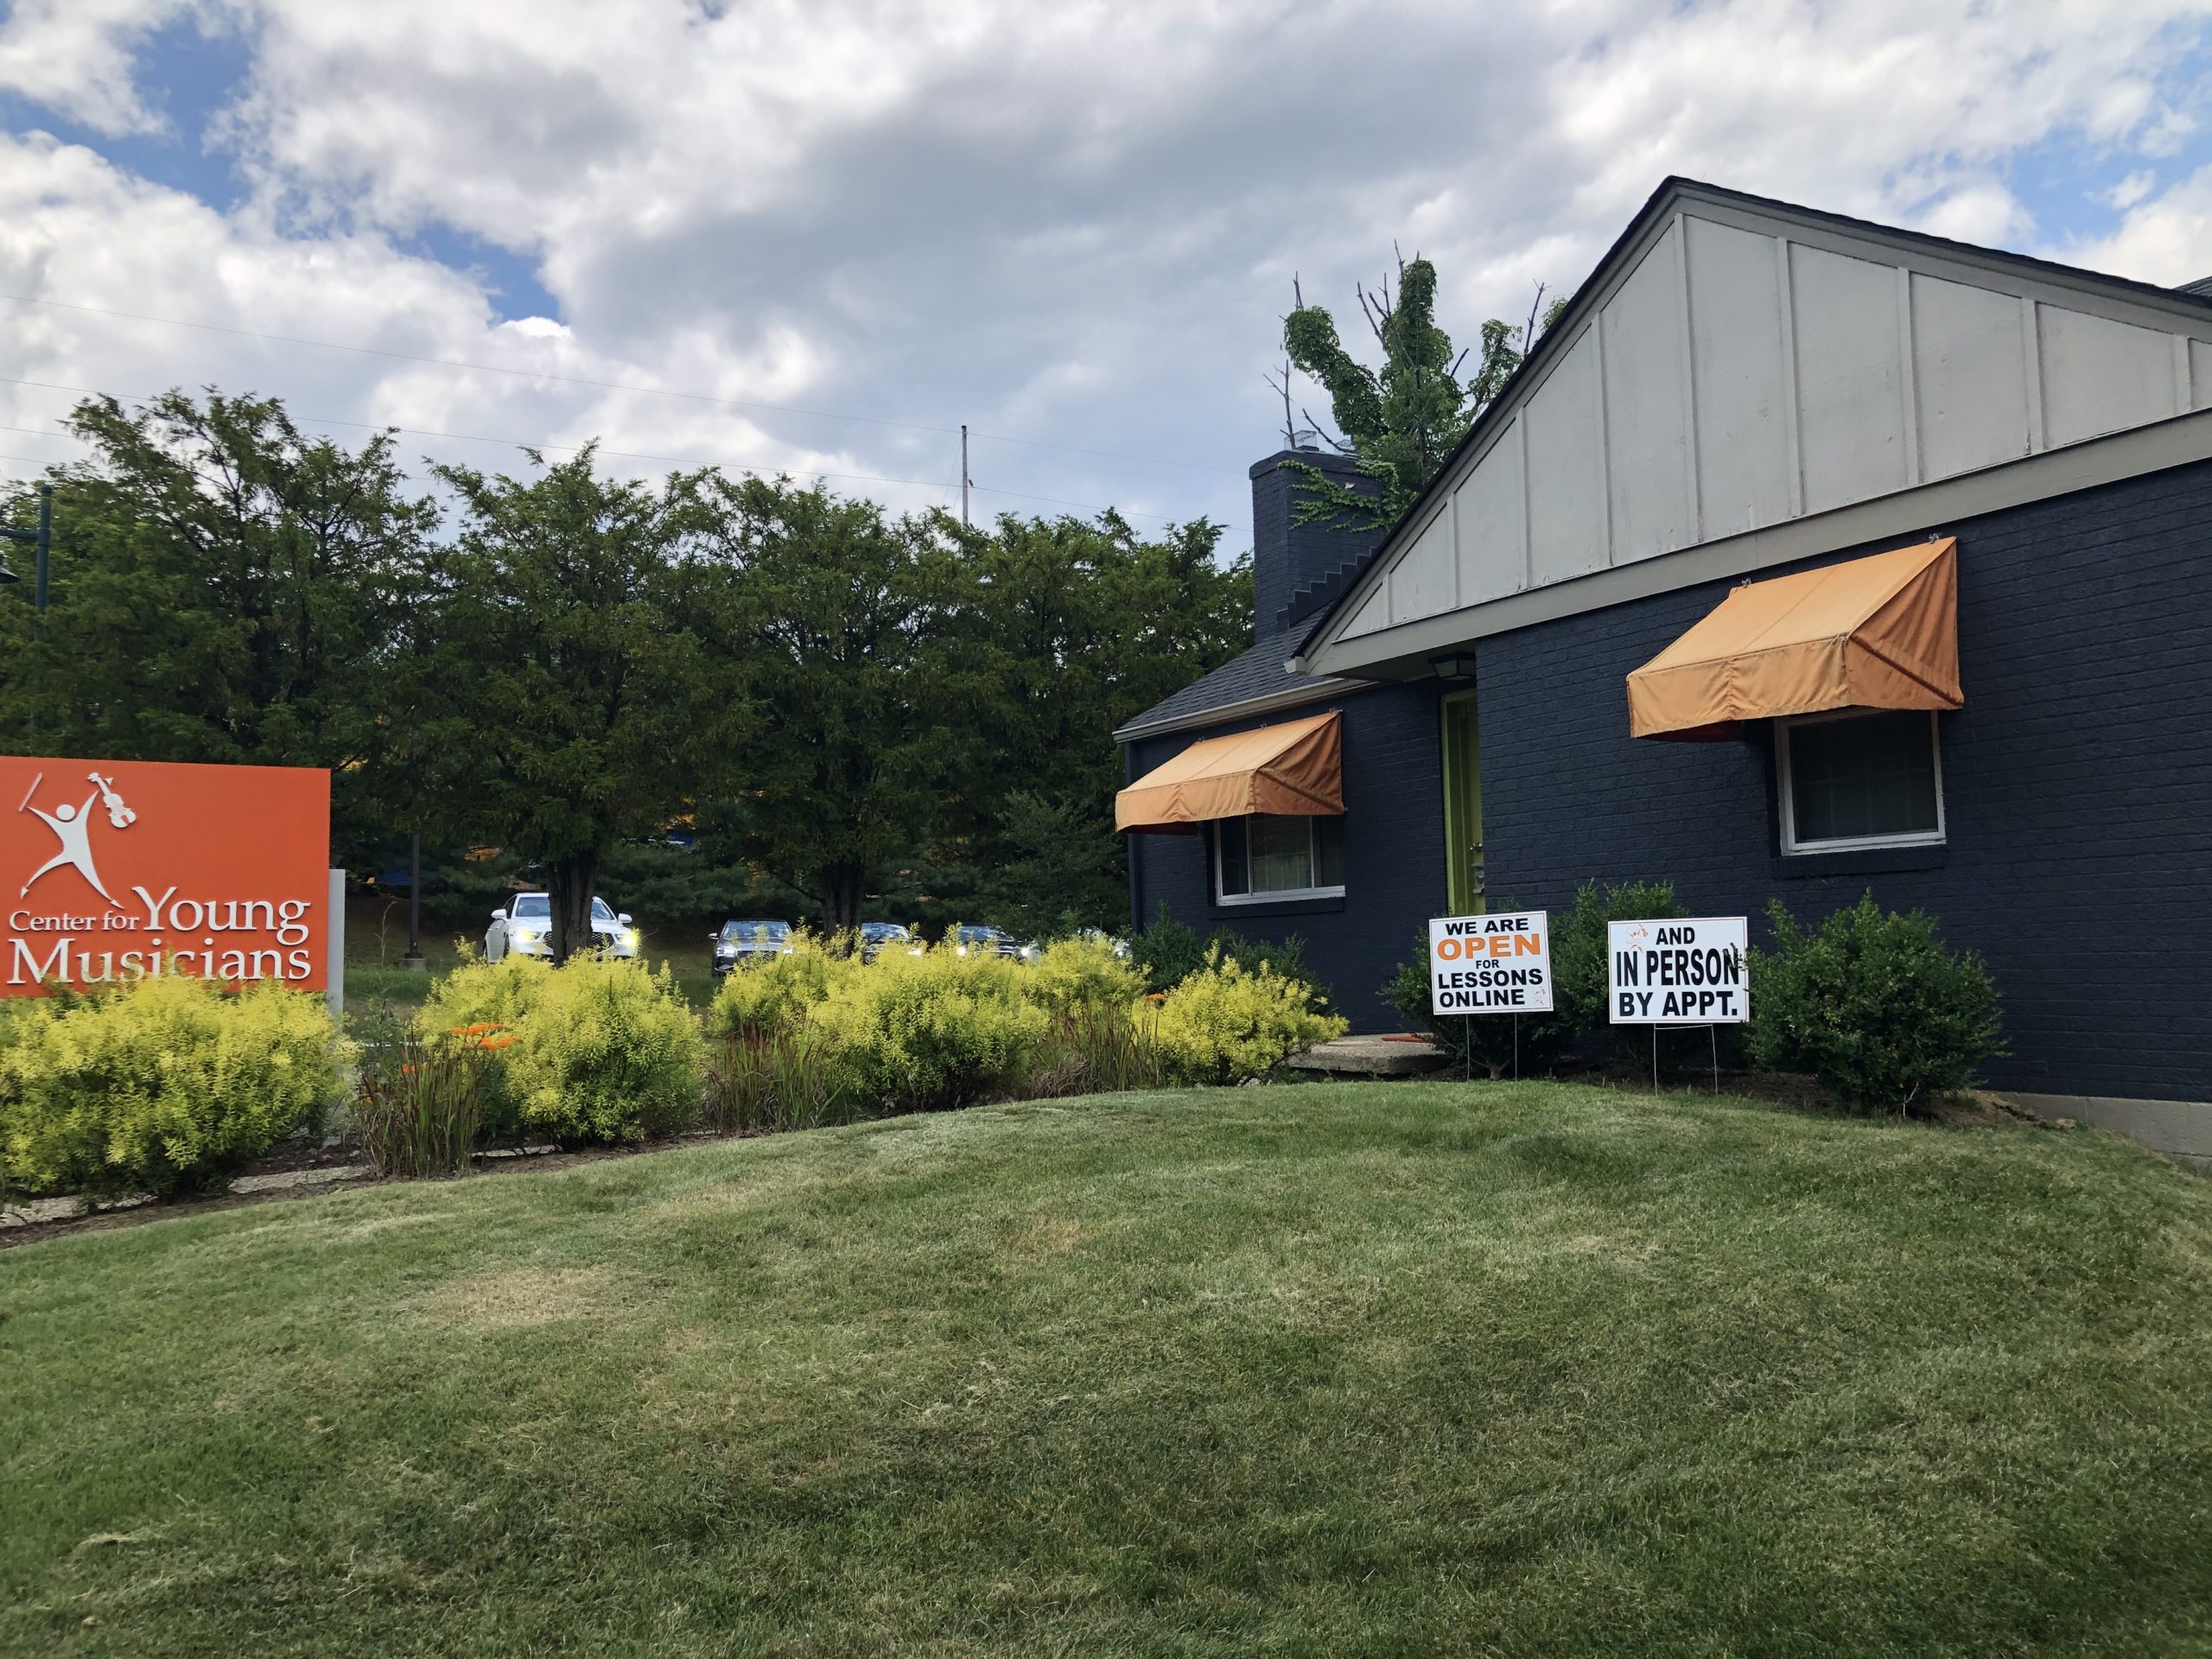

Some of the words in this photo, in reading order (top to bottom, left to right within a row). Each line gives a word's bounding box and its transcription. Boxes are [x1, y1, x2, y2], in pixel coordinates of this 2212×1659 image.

[10, 911, 96, 931] Center
[102, 910, 140, 931] for
[132, 887, 311, 945] Young
[1446, 921, 1477, 935] WE
[1484, 918, 1529, 933] ARE
[1437, 933, 1541, 961] OPEN
[1656, 927, 1695, 945] AND
[6, 938, 312, 984] Musicians
[1476, 959, 1499, 969] FOR
[1616, 950, 1638, 987] IN
[1646, 948, 1739, 986] PERSON
[1438, 969, 1542, 989] LESSONS
[1440, 988, 1525, 1007] ONLINE
[1619, 992, 1653, 1016] BY
[1662, 991, 1738, 1016] APPT.
